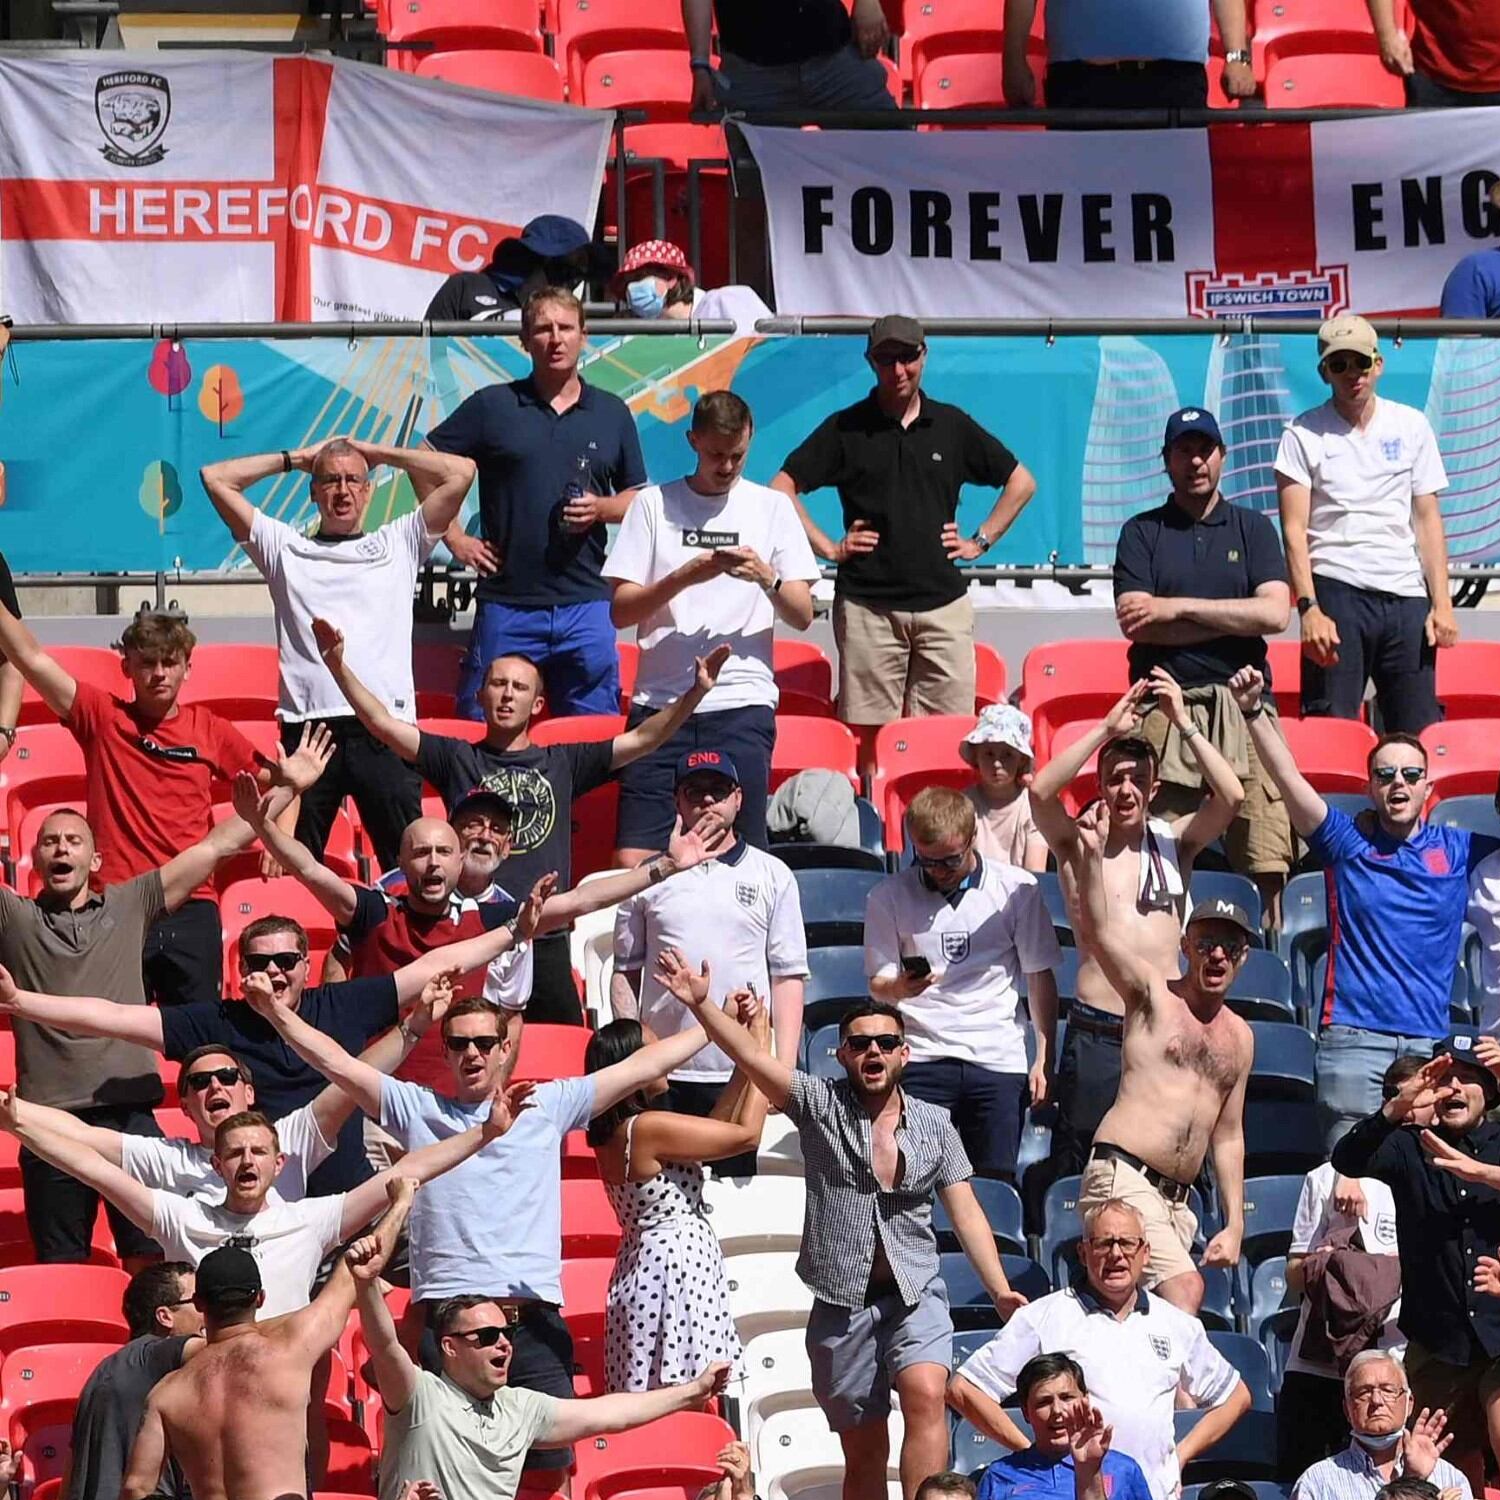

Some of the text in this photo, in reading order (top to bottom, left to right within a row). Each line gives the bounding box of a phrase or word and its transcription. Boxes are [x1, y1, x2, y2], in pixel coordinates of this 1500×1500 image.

[102, 75, 149, 87] HEREFORD
[90, 184, 489, 271] HEREFORD FC
[801, 185, 1176, 265] FOREVER
[313, 296, 332, 308] Our
[333, 301, 372, 317] greatest
[1210, 288, 1325, 307] IPSWICH TOWN
[687, 752, 720, 767] ENG
[1216, 899, 1234, 916] M
